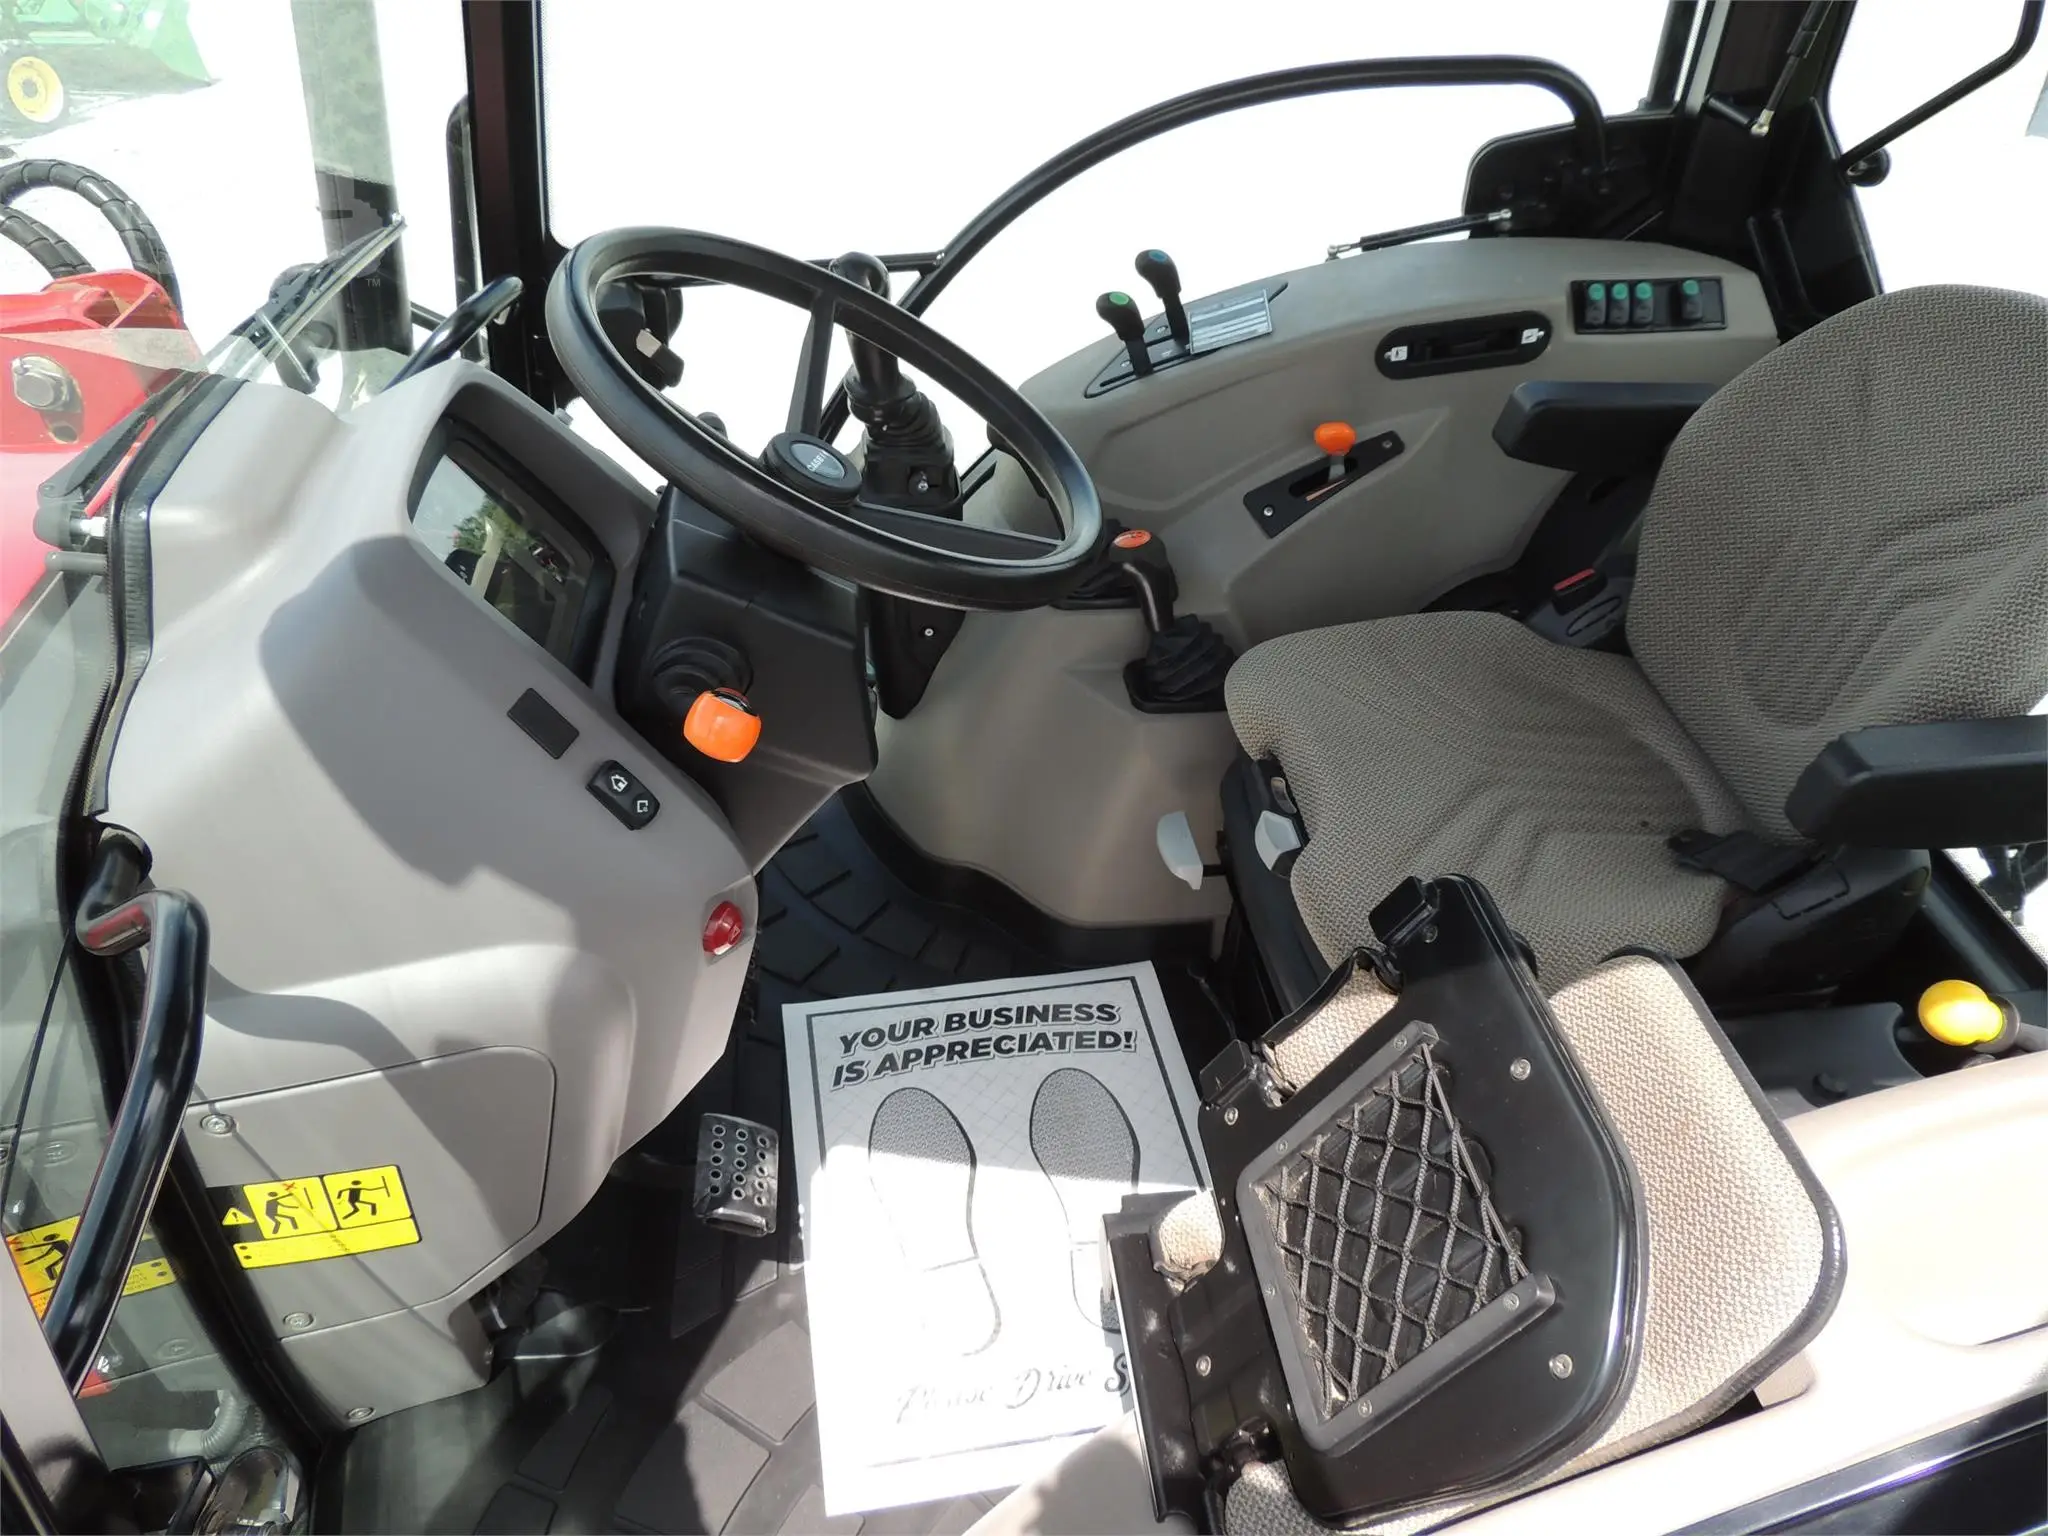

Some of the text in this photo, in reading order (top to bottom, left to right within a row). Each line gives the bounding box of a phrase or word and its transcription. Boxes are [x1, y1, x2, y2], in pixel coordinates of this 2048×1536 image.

[839, 1003, 1119, 1056] YOUR BUSINESS
[832, 1030, 1136, 1088] IS APPRECIATED!
